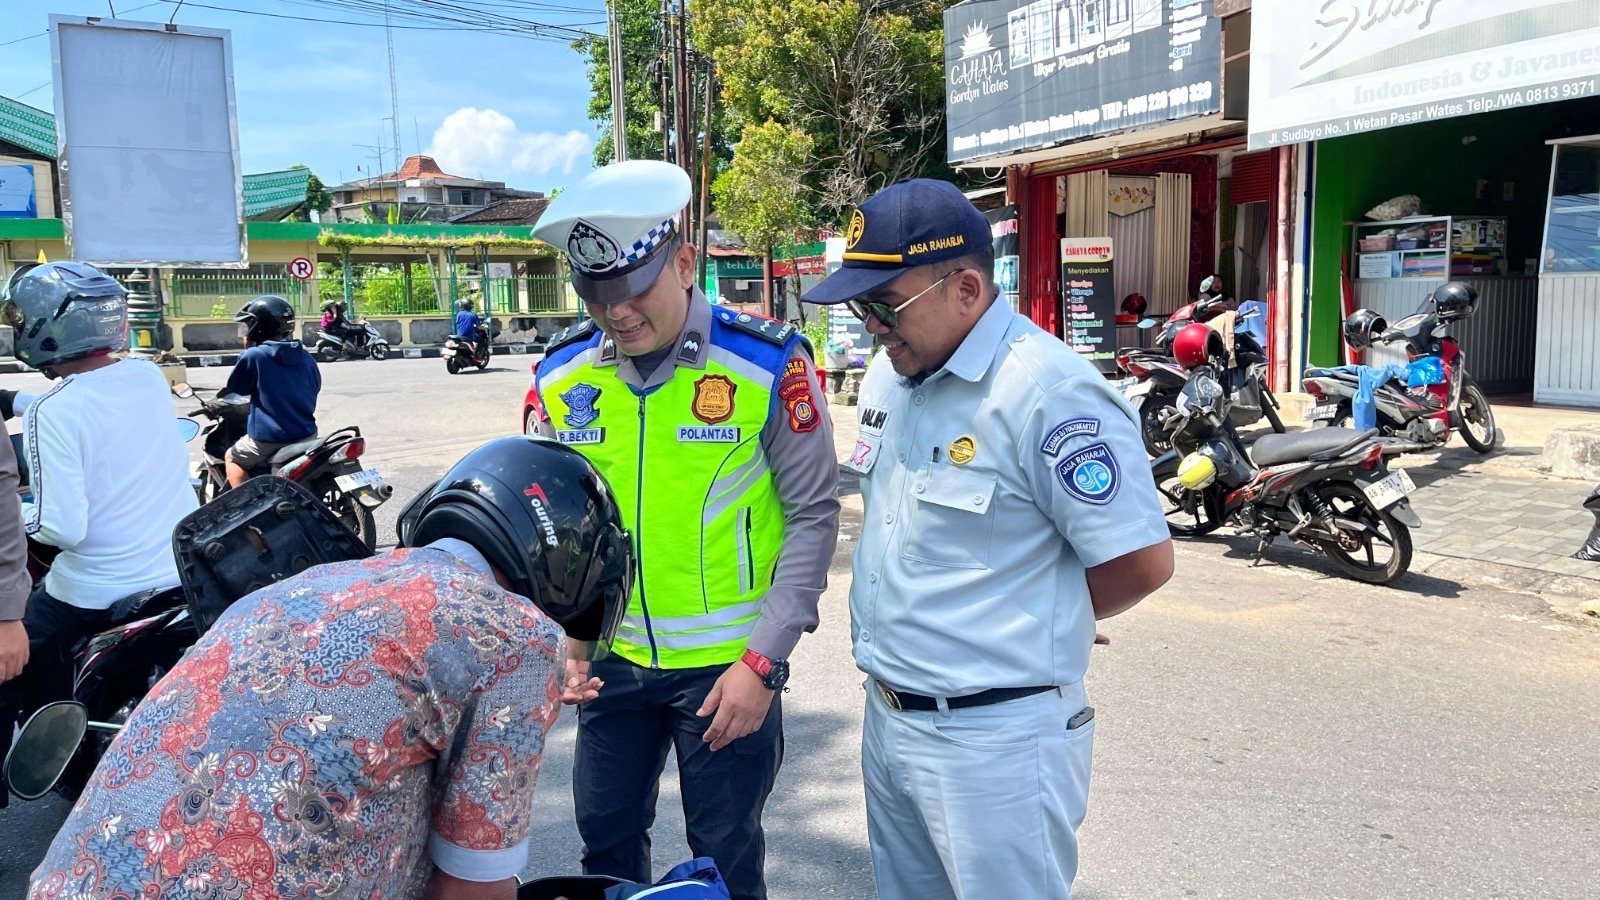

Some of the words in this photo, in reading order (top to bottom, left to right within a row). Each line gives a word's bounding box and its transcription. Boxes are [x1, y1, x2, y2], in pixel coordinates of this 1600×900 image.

[1097, 39, 1130, 59] Gratis
[951, 50, 1007, 86] CAHAYA
[983, 79, 1009, 95] Wates
[1352, 69, 1464, 105] Indonesia
[1468, 60, 1491, 83] &
[1269, 133, 1279, 144] Jl.
[1282, 125, 1323, 143] Sudibyo
[1325, 122, 1341, 136] No.
[1345, 121, 1350, 132] 1
[1353, 115, 1388, 131] Wetan
[1390, 109, 1423, 126] Pasar
[1426, 103, 1464, 119] Wates
[1466, 92, 1523, 114] Telp./WA
[1526, 84, 1559, 103] 0813
[1562, 79, 1596, 97] 9371
[908, 243, 929, 256] JASA
[929, 234, 965, 252] RAHARJA
[1067, 267, 1109, 275] Menyediakan
[560, 430, 598, 443] R.BEKTI
[680, 428, 734, 441] POLANTAS
[1060, 461, 1077, 475] JASA
[1075, 448, 1106, 463] RAHARJA
[523, 482, 560, 549] Touring
